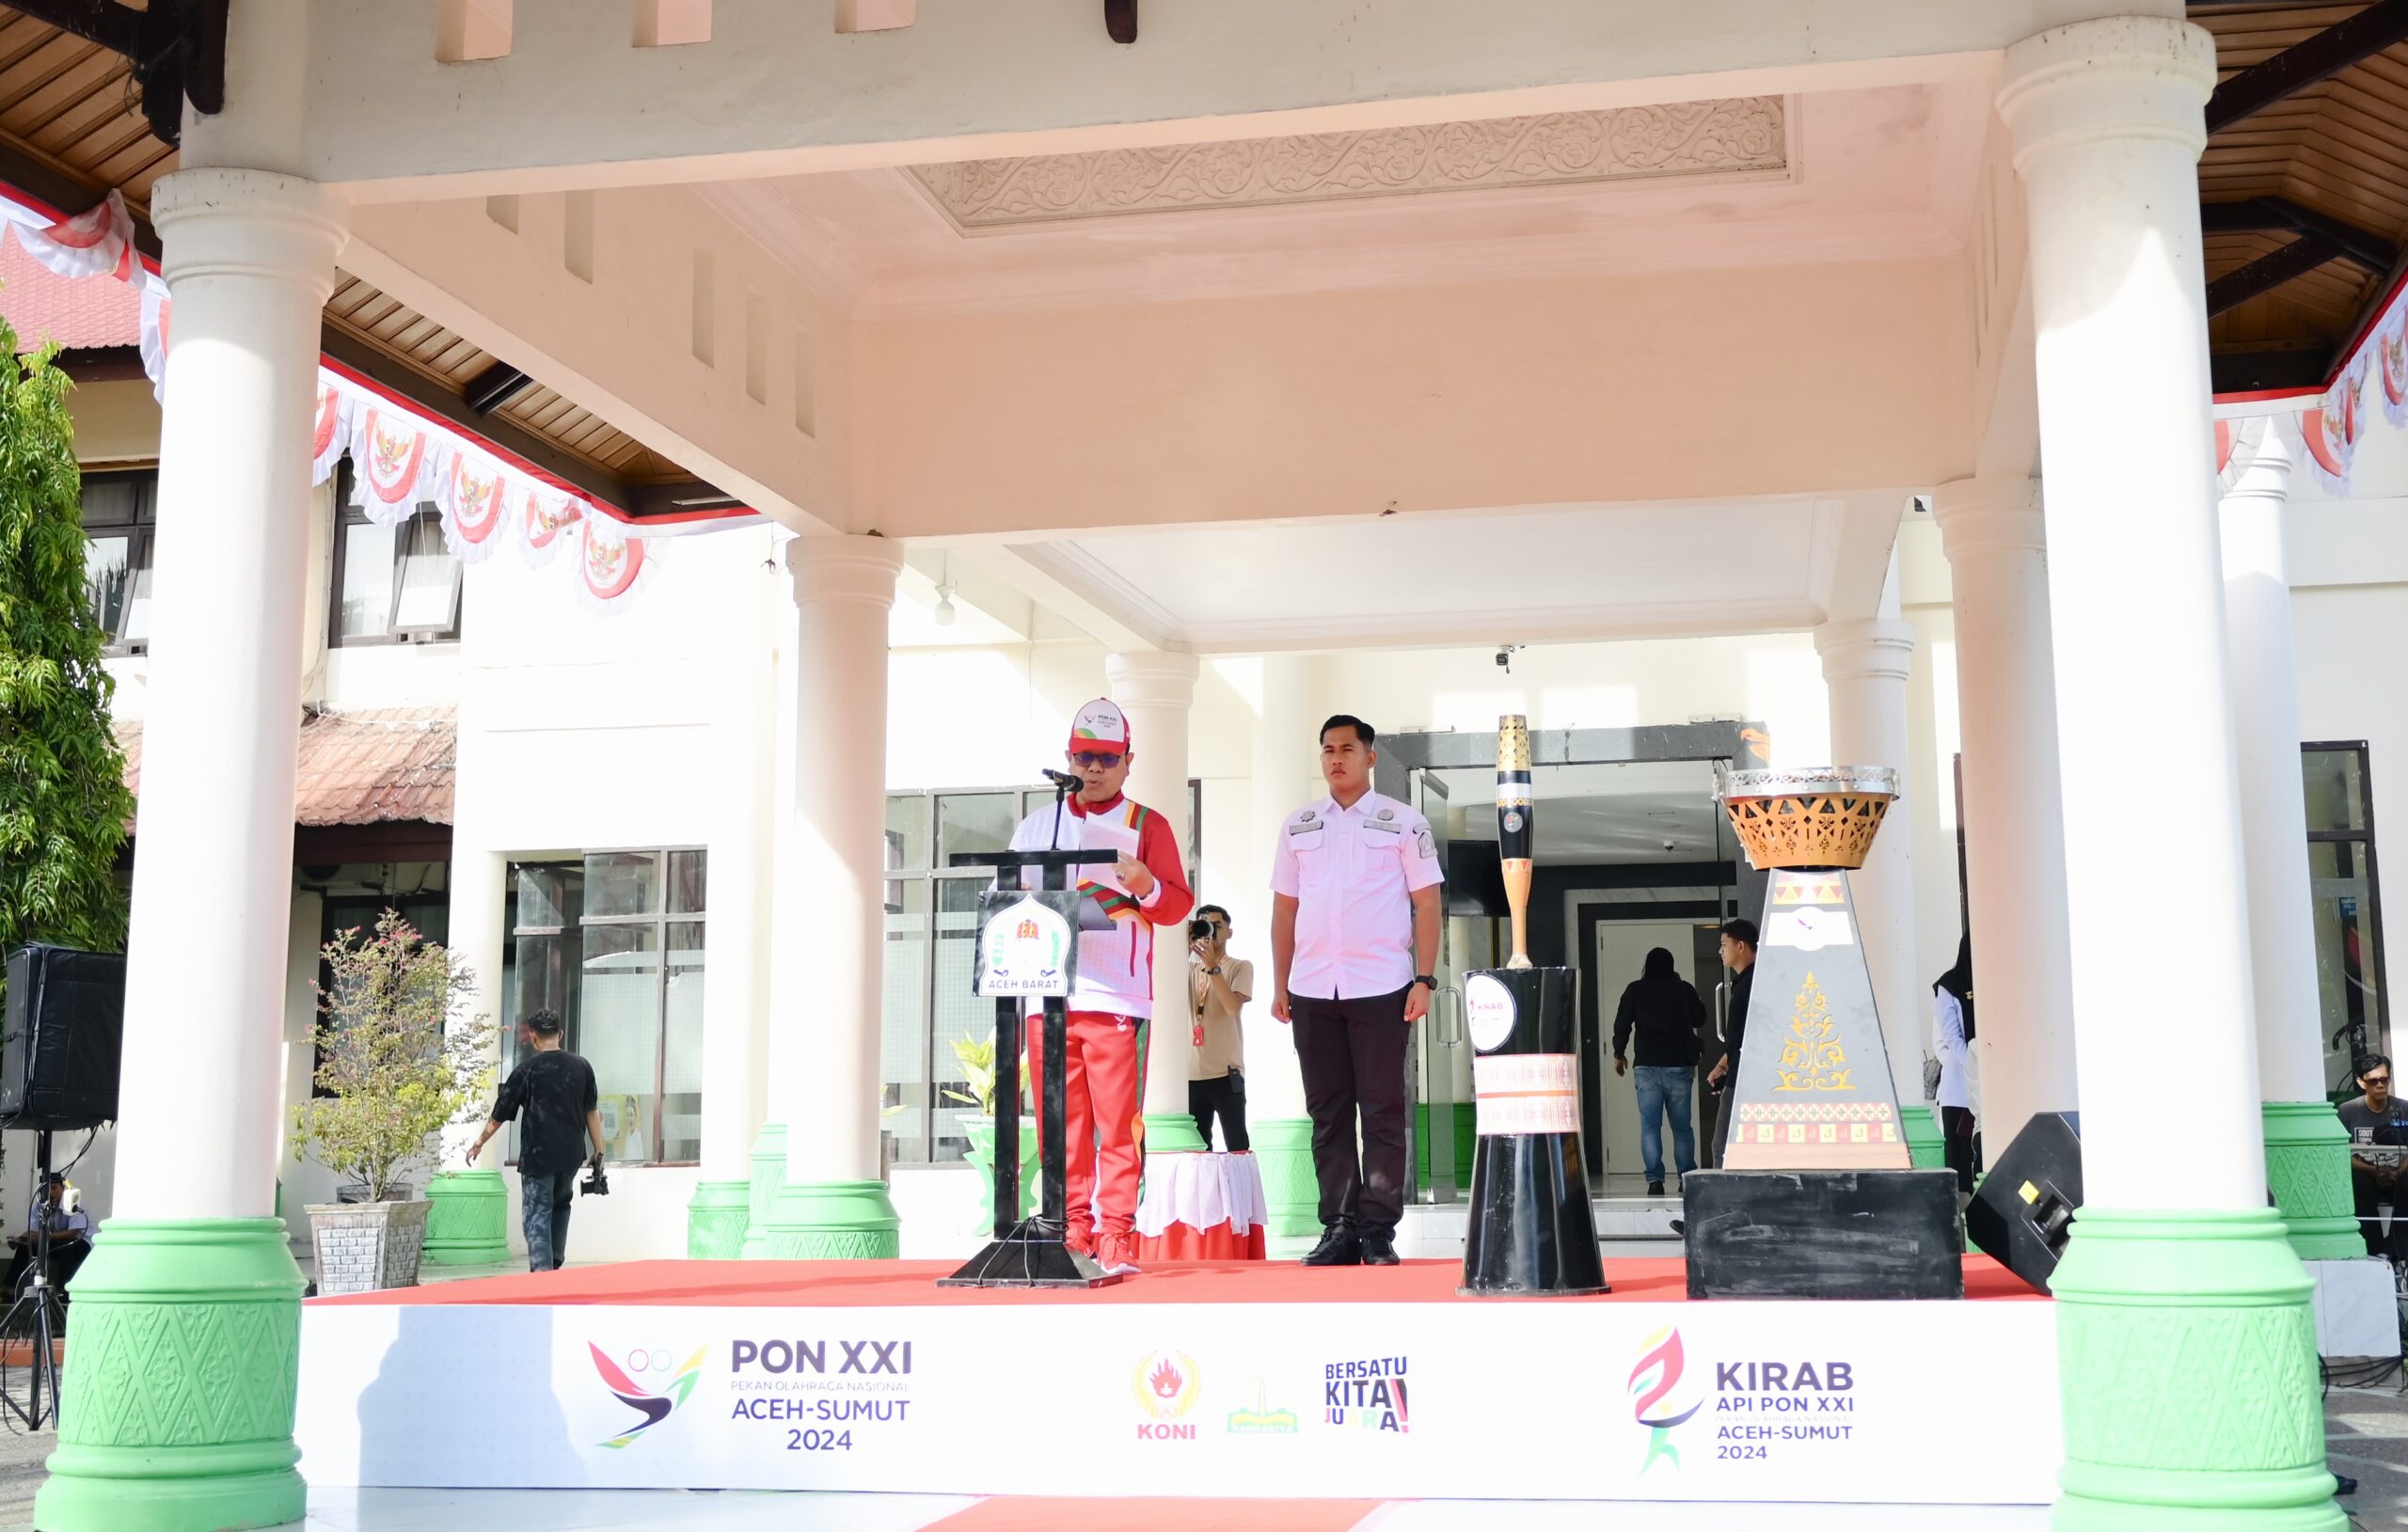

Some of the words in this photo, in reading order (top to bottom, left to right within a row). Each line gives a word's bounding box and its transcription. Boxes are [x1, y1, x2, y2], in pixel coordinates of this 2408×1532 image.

[989, 980, 1018, 989] ACEH
[1022, 980, 1058, 989] BARAT
[732, 1339, 826, 1374] PON
[838, 1340, 911, 1374] XXI
[1325, 1356, 1407, 1380] BERSATU
[1716, 1361, 1854, 1392] KIRAB
[731, 1381, 772, 1391] PEKAN
[775, 1381, 844, 1392] OLAHRAGA
[847, 1382, 910, 1392] NASIONAL
[731, 1398, 911, 1421] ACEH-SUMUT
[1716, 1397, 1752, 1413] API
[1760, 1397, 1809, 1413] PON
[1816, 1397, 1854, 1413] XXI
[786, 1429, 853, 1451] 2024
[1137, 1424, 1196, 1440] KONI
[1717, 1426, 1853, 1440] ACEH-SUMUT
[1717, 1445, 1767, 1460] 2024
